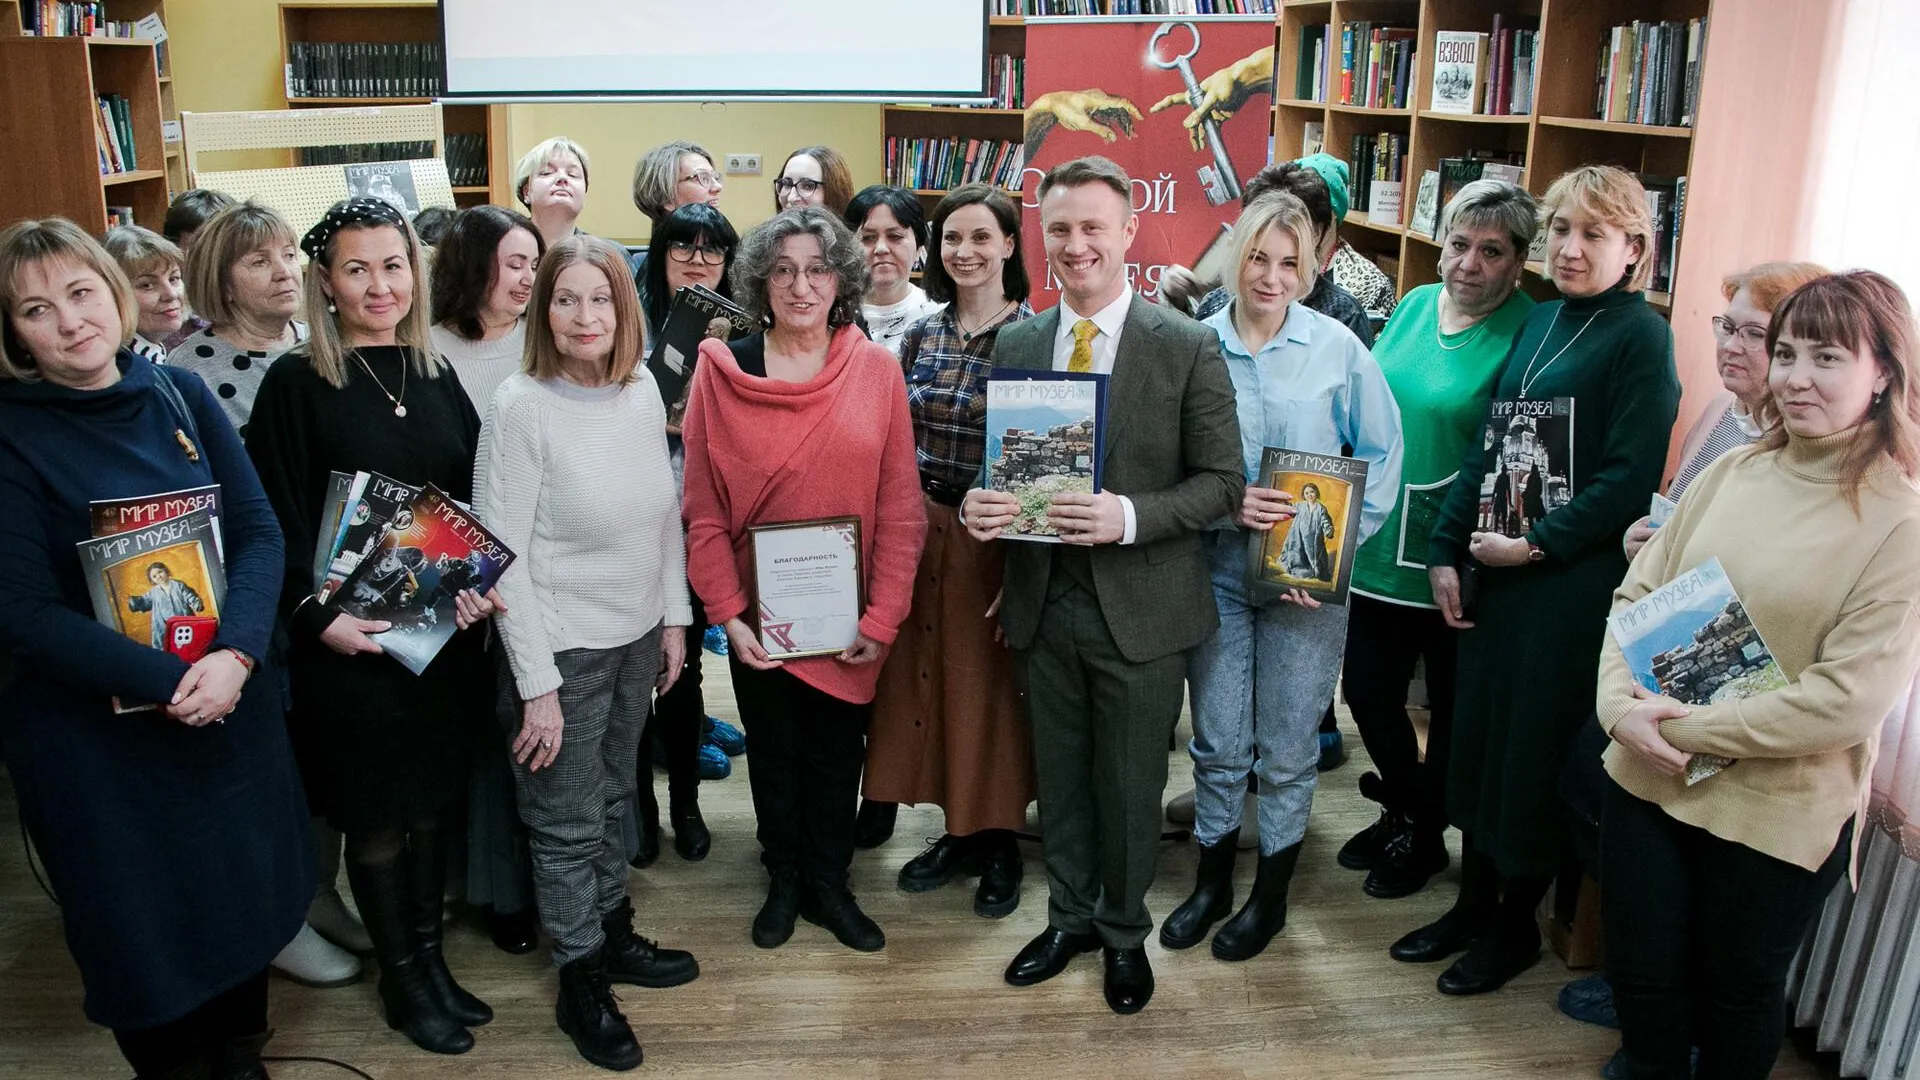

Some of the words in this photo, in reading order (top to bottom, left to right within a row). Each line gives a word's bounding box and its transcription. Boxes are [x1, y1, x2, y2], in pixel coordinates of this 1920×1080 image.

[1438, 41, 1475, 64] ВЗВОД
[685, 292, 714, 313] МИР
[994, 384, 1025, 398] МИР
[1030, 384, 1076, 399] МУЗЕЯ
[1492, 401, 1513, 415] МИР
[1515, 401, 1553, 415] МУЗЕЯ
[1268, 450, 1301, 466] МИР
[1304, 455, 1350, 474] МУЗЕЯ
[373, 479, 410, 501] МИР
[120, 503, 160, 524] МИР
[164, 493, 216, 518] МУЗЕЯ
[88, 538, 130, 561] МИР
[135, 519, 191, 551] МУЗЕЯ
[434, 502, 468, 530] МИР
[464, 526, 509, 567] МУЗЕЯ
[774, 553, 838, 564] БЛАГОДАРНОСТЬ
[1617, 600, 1650, 633] МИР
[1652, 572, 1704, 614] МУЗЕЯ
